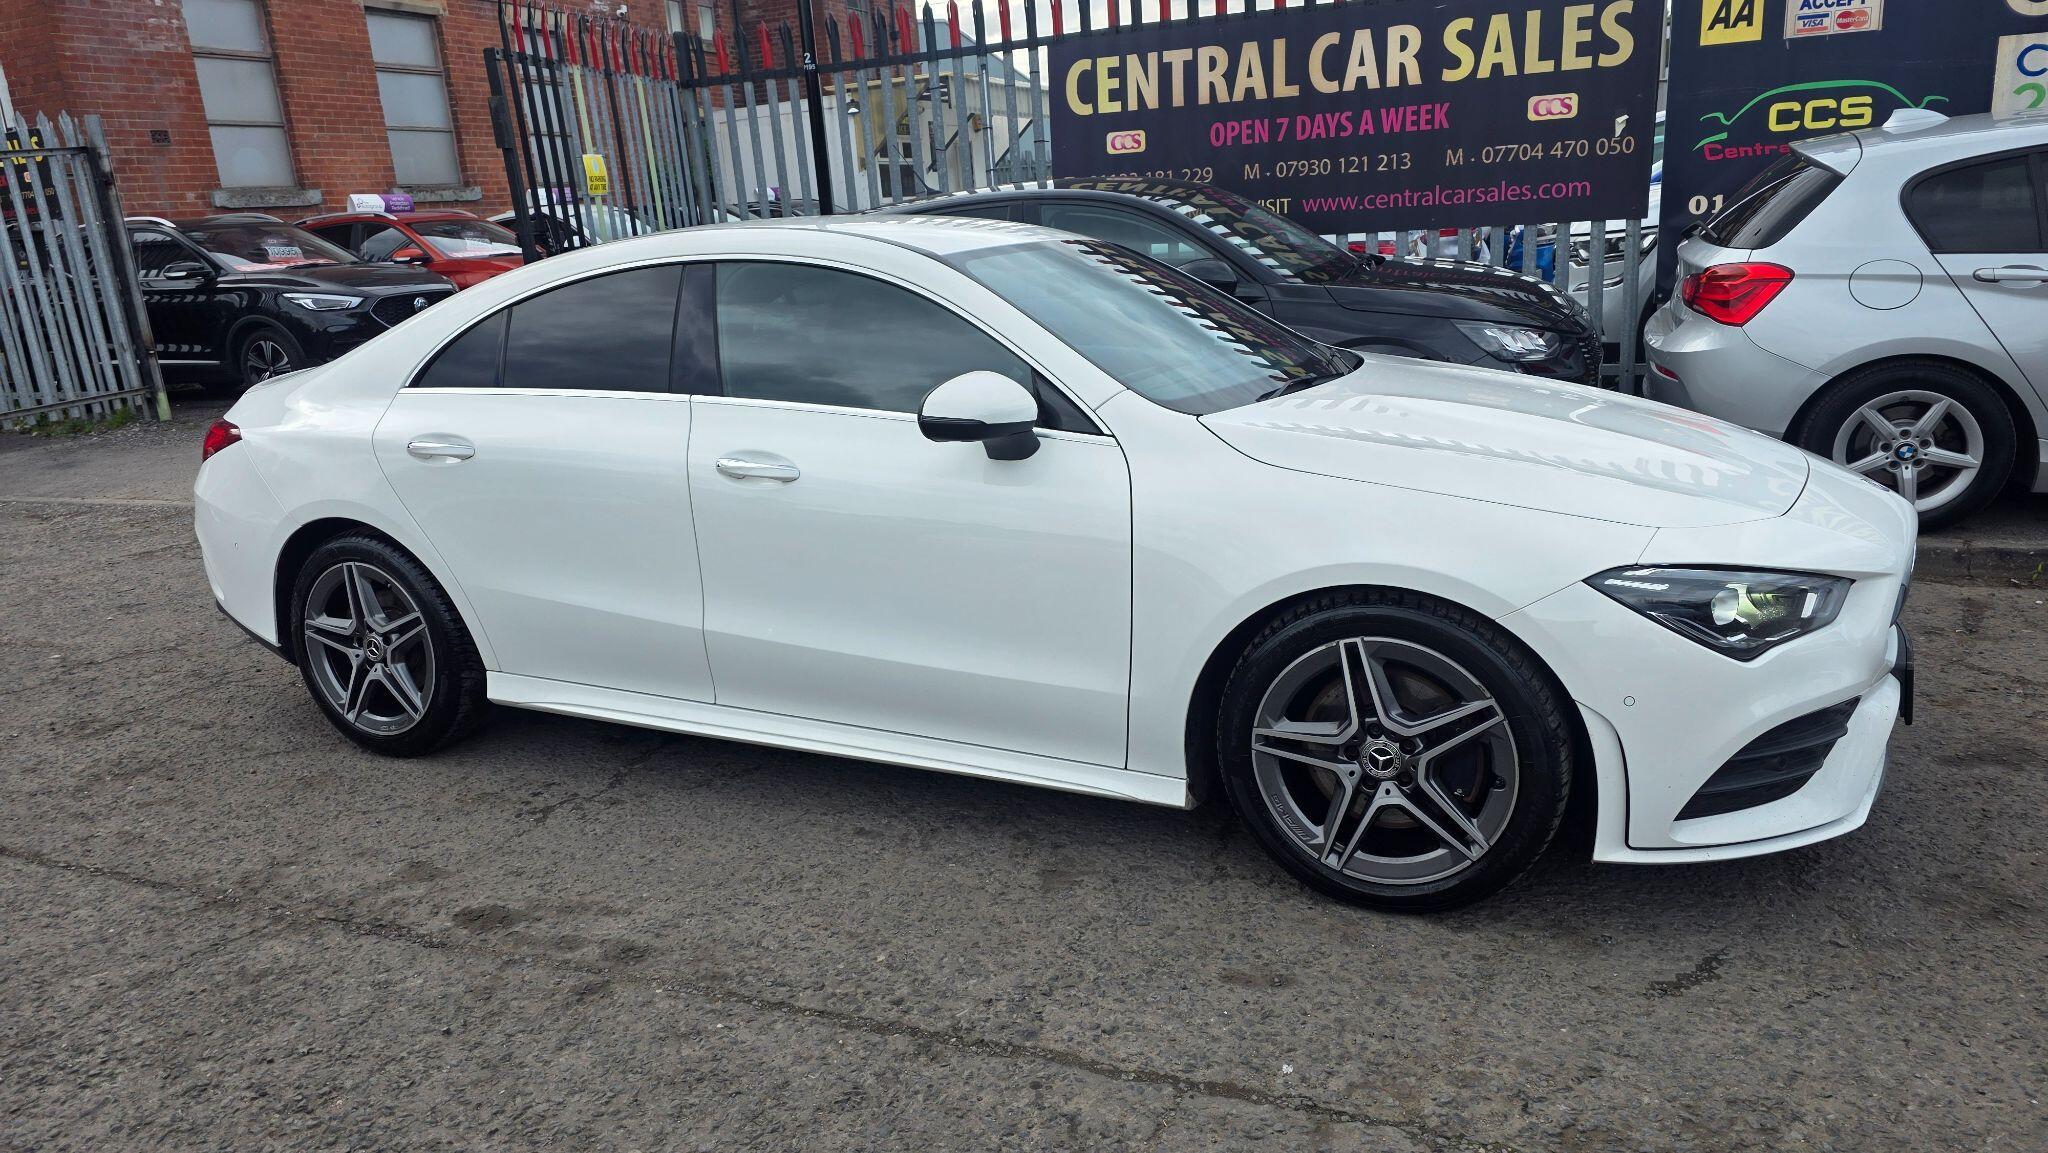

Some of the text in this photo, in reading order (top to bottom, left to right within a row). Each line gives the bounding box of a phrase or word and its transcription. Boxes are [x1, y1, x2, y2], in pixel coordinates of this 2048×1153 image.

[1707, 0, 1755, 31] AA
[1802, 18, 1824, 28] VISA
[803, 52, 811, 63] 2
[1065, 0, 1634, 116] CENTRAL CAR SALES
[1532, 96, 1573, 117] CCS
[1768, 95, 1873, 132] CCS
[1210, 102, 1450, 147] OPEN 7 DAYS A WEEK
[1181, 167, 1213, 183] 229
[1275, 158, 1331, 178] 07930
[1338, 156, 1368, 173] 121
[1377, 152, 1411, 171] 213
[1481, 143, 1543, 164] 07704
[1550, 139, 1589, 158] 470
[1596, 136, 1635, 156] 050
[1302, 179, 1591, 213] www.centralcarsales.com
